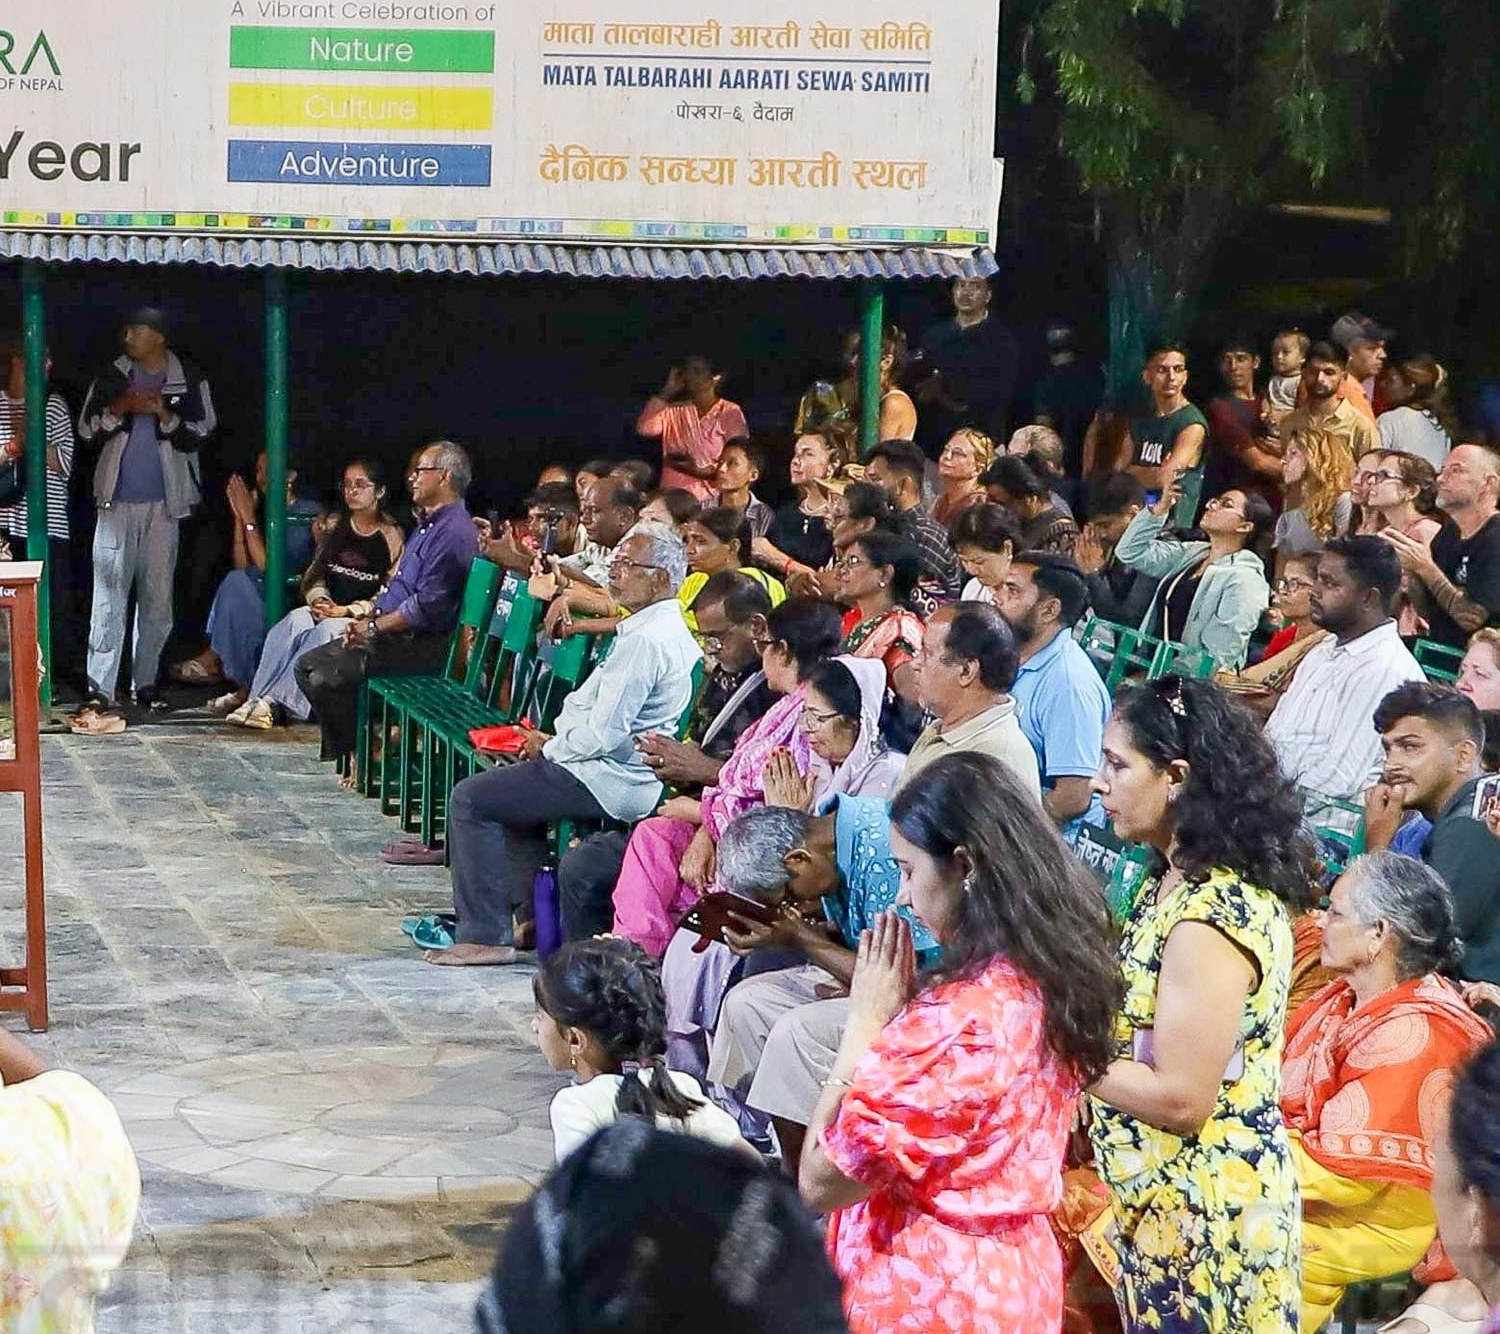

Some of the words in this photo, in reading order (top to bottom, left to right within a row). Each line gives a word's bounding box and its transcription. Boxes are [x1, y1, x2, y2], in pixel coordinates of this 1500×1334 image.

[231, 0, 245, 17] A
[257, 0, 336, 20] Vibrant
[342, 0, 468, 21] Celebration
[473, 2, 496, 21] of
[309, 36, 414, 63] Nature
[543, 20, 594, 47] माता
[603, 18, 720, 50] तालबाराही
[729, 19, 799, 50] आरती
[809, 21, 851, 51] सेवा
[859, 23, 932, 53] समिति
[20, 76, 63, 91] NEPAL
[543, 64, 597, 88] MATA
[603, 65, 713, 90] TALBARAHI
[718, 67, 790, 91] AARATI
[797, 69, 854, 92] SEWA
[860, 70, 931, 94] SAMITI
[305, 93, 417, 121] Culture
[279, 149, 439, 180] Adventure
[538, 144, 628, 185] दैनिक
[639, 155, 736, 187] सन्ध्या
[748, 148, 840, 189] आरती
[854, 160, 927, 191] स्थल
